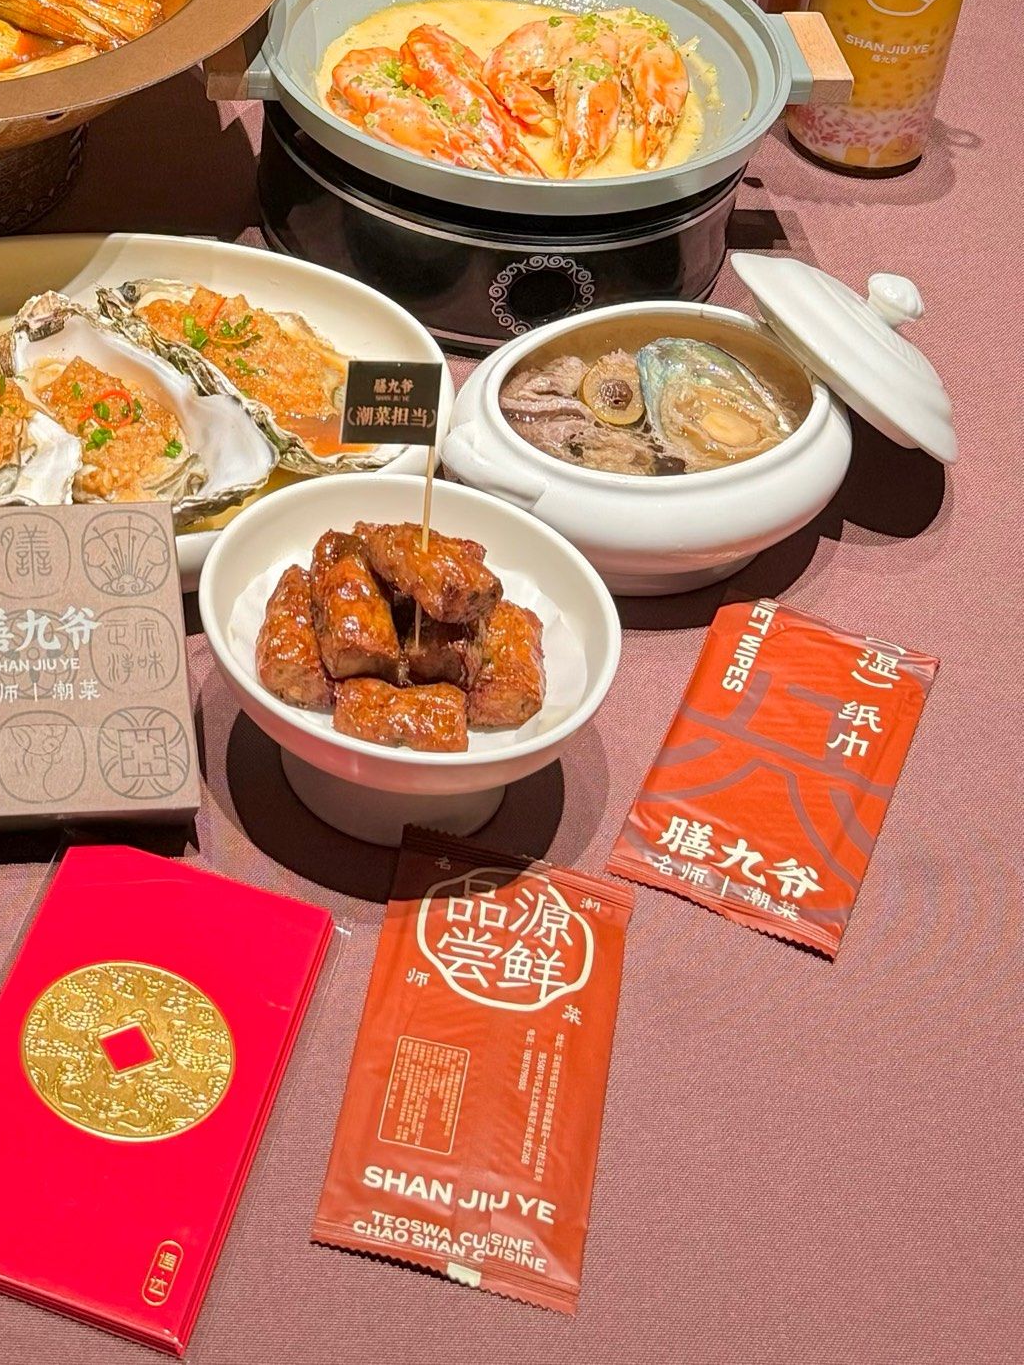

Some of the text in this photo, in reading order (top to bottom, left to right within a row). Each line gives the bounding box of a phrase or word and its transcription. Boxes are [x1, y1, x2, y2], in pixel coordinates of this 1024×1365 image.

[845, 34, 930, 55] SHAN JIU YE
[373, 378, 414, 394] 膳九爷
[32, 659, 57, 671] JIU
[59, 657, 81, 669] YE
[722, 634, 764, 693] WIPES
[52, 678, 101, 701] 潮菜
[656, 816, 824, 898] 膳九爷
[653, 855, 801, 923] 名师 潮菜
[406, 967, 431, 987] 师
[362, 1165, 557, 1225] SHAN JIU YE
[353, 1220, 548, 1273] CHAO SHAN CUISINE
[371, 1210, 534, 1255] TEOSWA CUISINE
